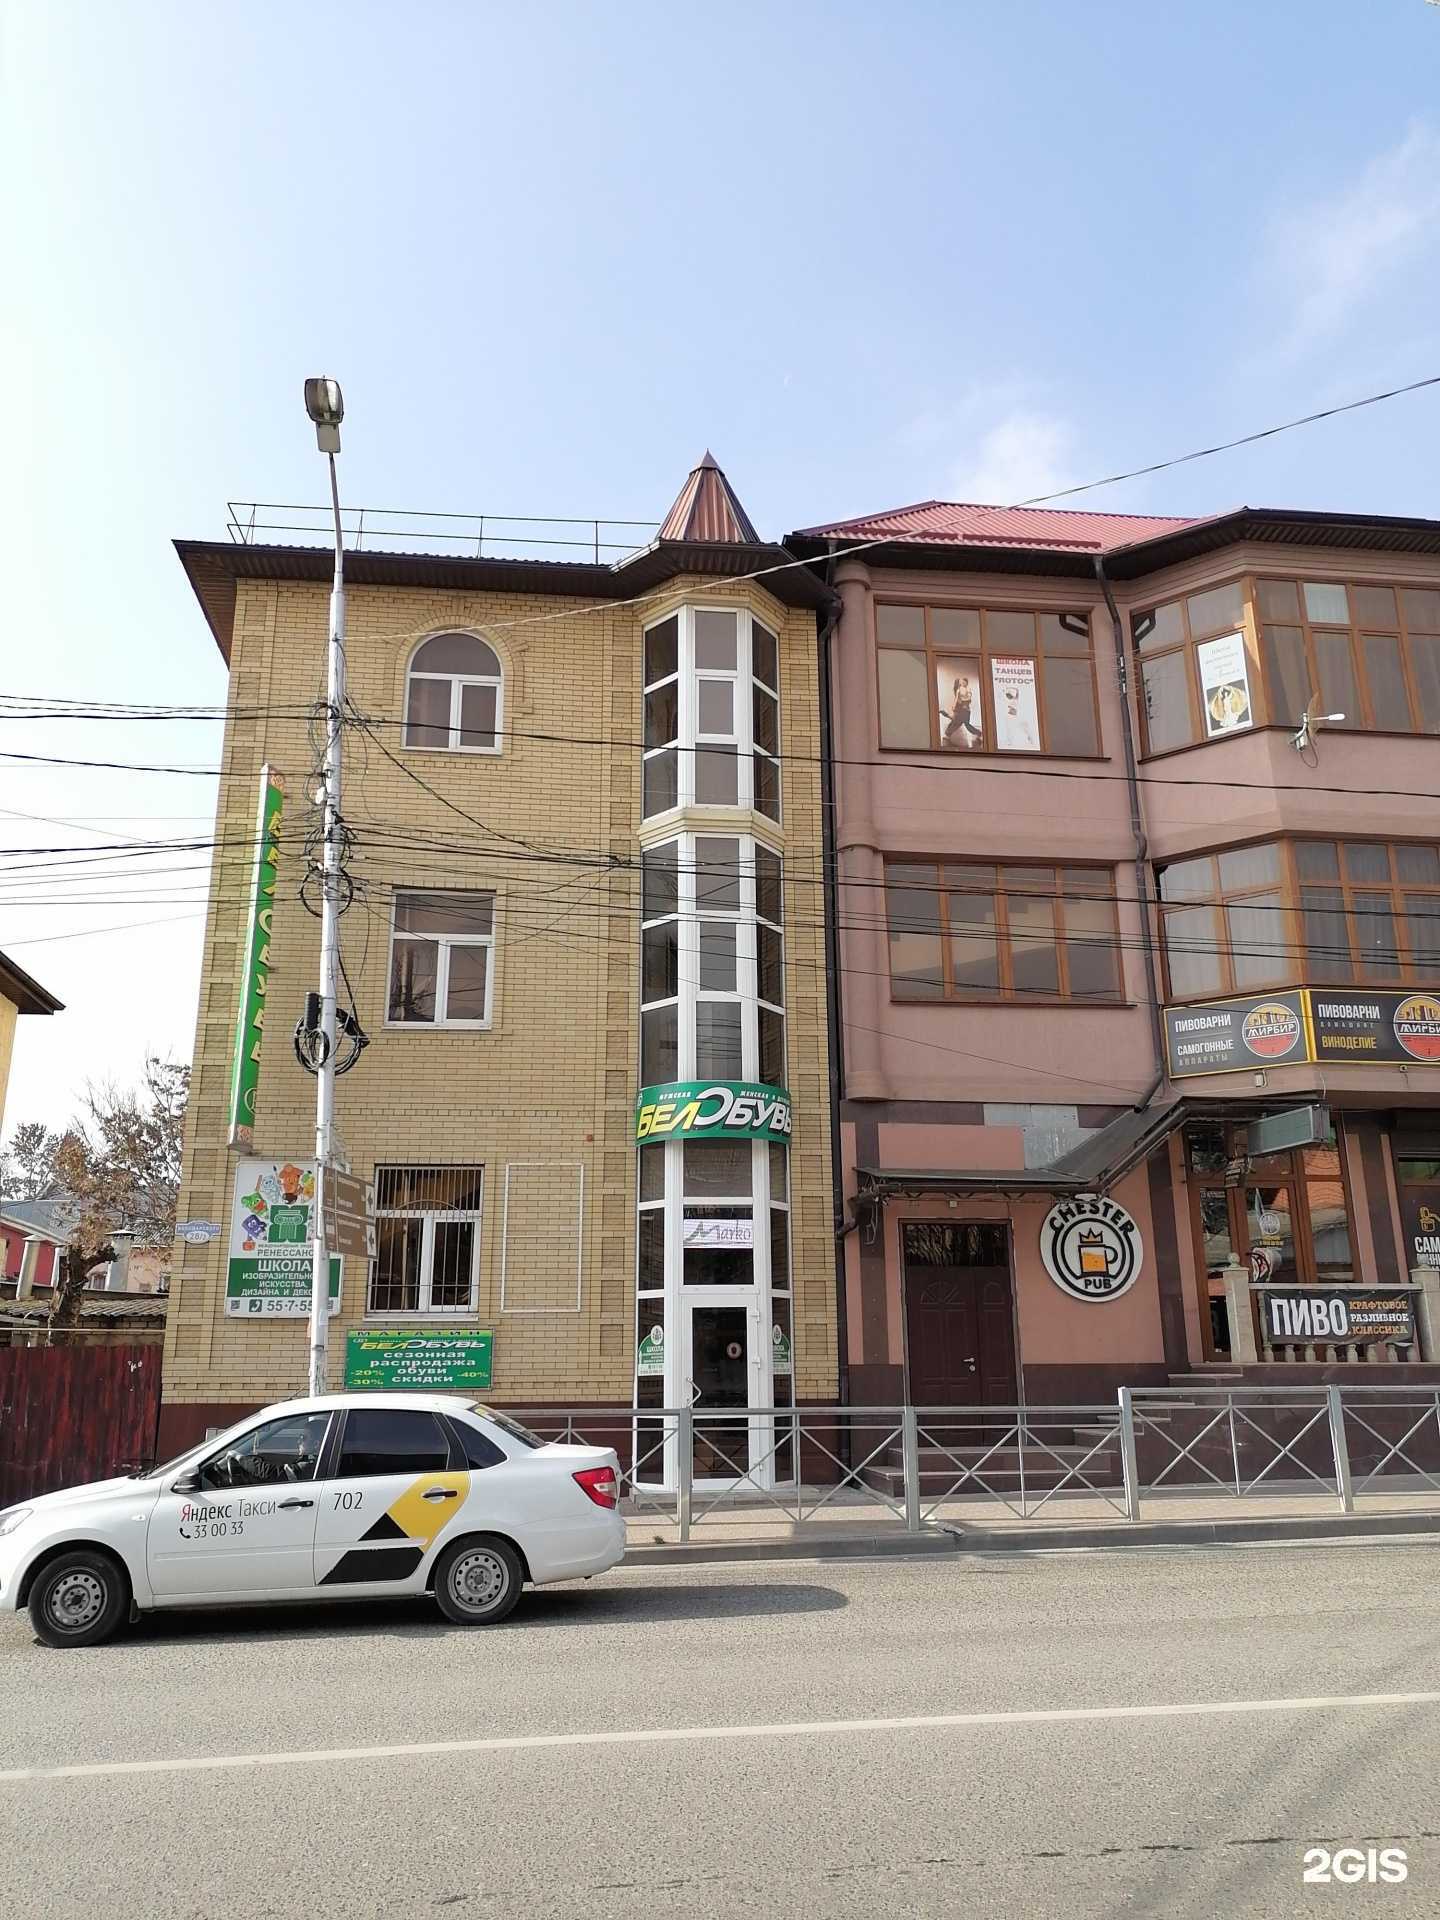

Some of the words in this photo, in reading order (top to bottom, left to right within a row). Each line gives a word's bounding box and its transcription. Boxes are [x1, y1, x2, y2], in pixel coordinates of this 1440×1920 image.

[1318, 1003, 1381, 1019] ПИВОВАРНИ
[1174, 1013, 1232, 1033] ПИВОВАРНИ
[1247, 1022, 1296, 1038] МИРБИР
[1177, 1039, 1234, 1056] САМОГОННЫЕ
[1321, 1035, 1377, 1050] ВИНОДЕЛИЕ
[1049, 1202, 1135, 1233] CHESTER
[257, 1260, 311, 1272] ШКОЛА
[241, 1288, 280, 1296] ДИЗАЙНА
[1084, 1279, 1112, 1289] PUB
[1271, 1299, 1348, 1336] ПИВО
[1349, 1300, 1408, 1310] КРАФТОВОЕ
[1350, 1313, 1409, 1322] РАЗЛИВНОЕ
[370, 1359, 476, 1368] распродажа
[397, 1367, 447, 1375] обуви
[333, 1492, 363, 1511] 702
[181, 1503, 233, 1522] Яндекс
[238, 1499, 277, 1517] Такси
[194, 1525, 207, 1539] 33
[211, 1523, 227, 1537] 00
[231, 1521, 244, 1535] 33
